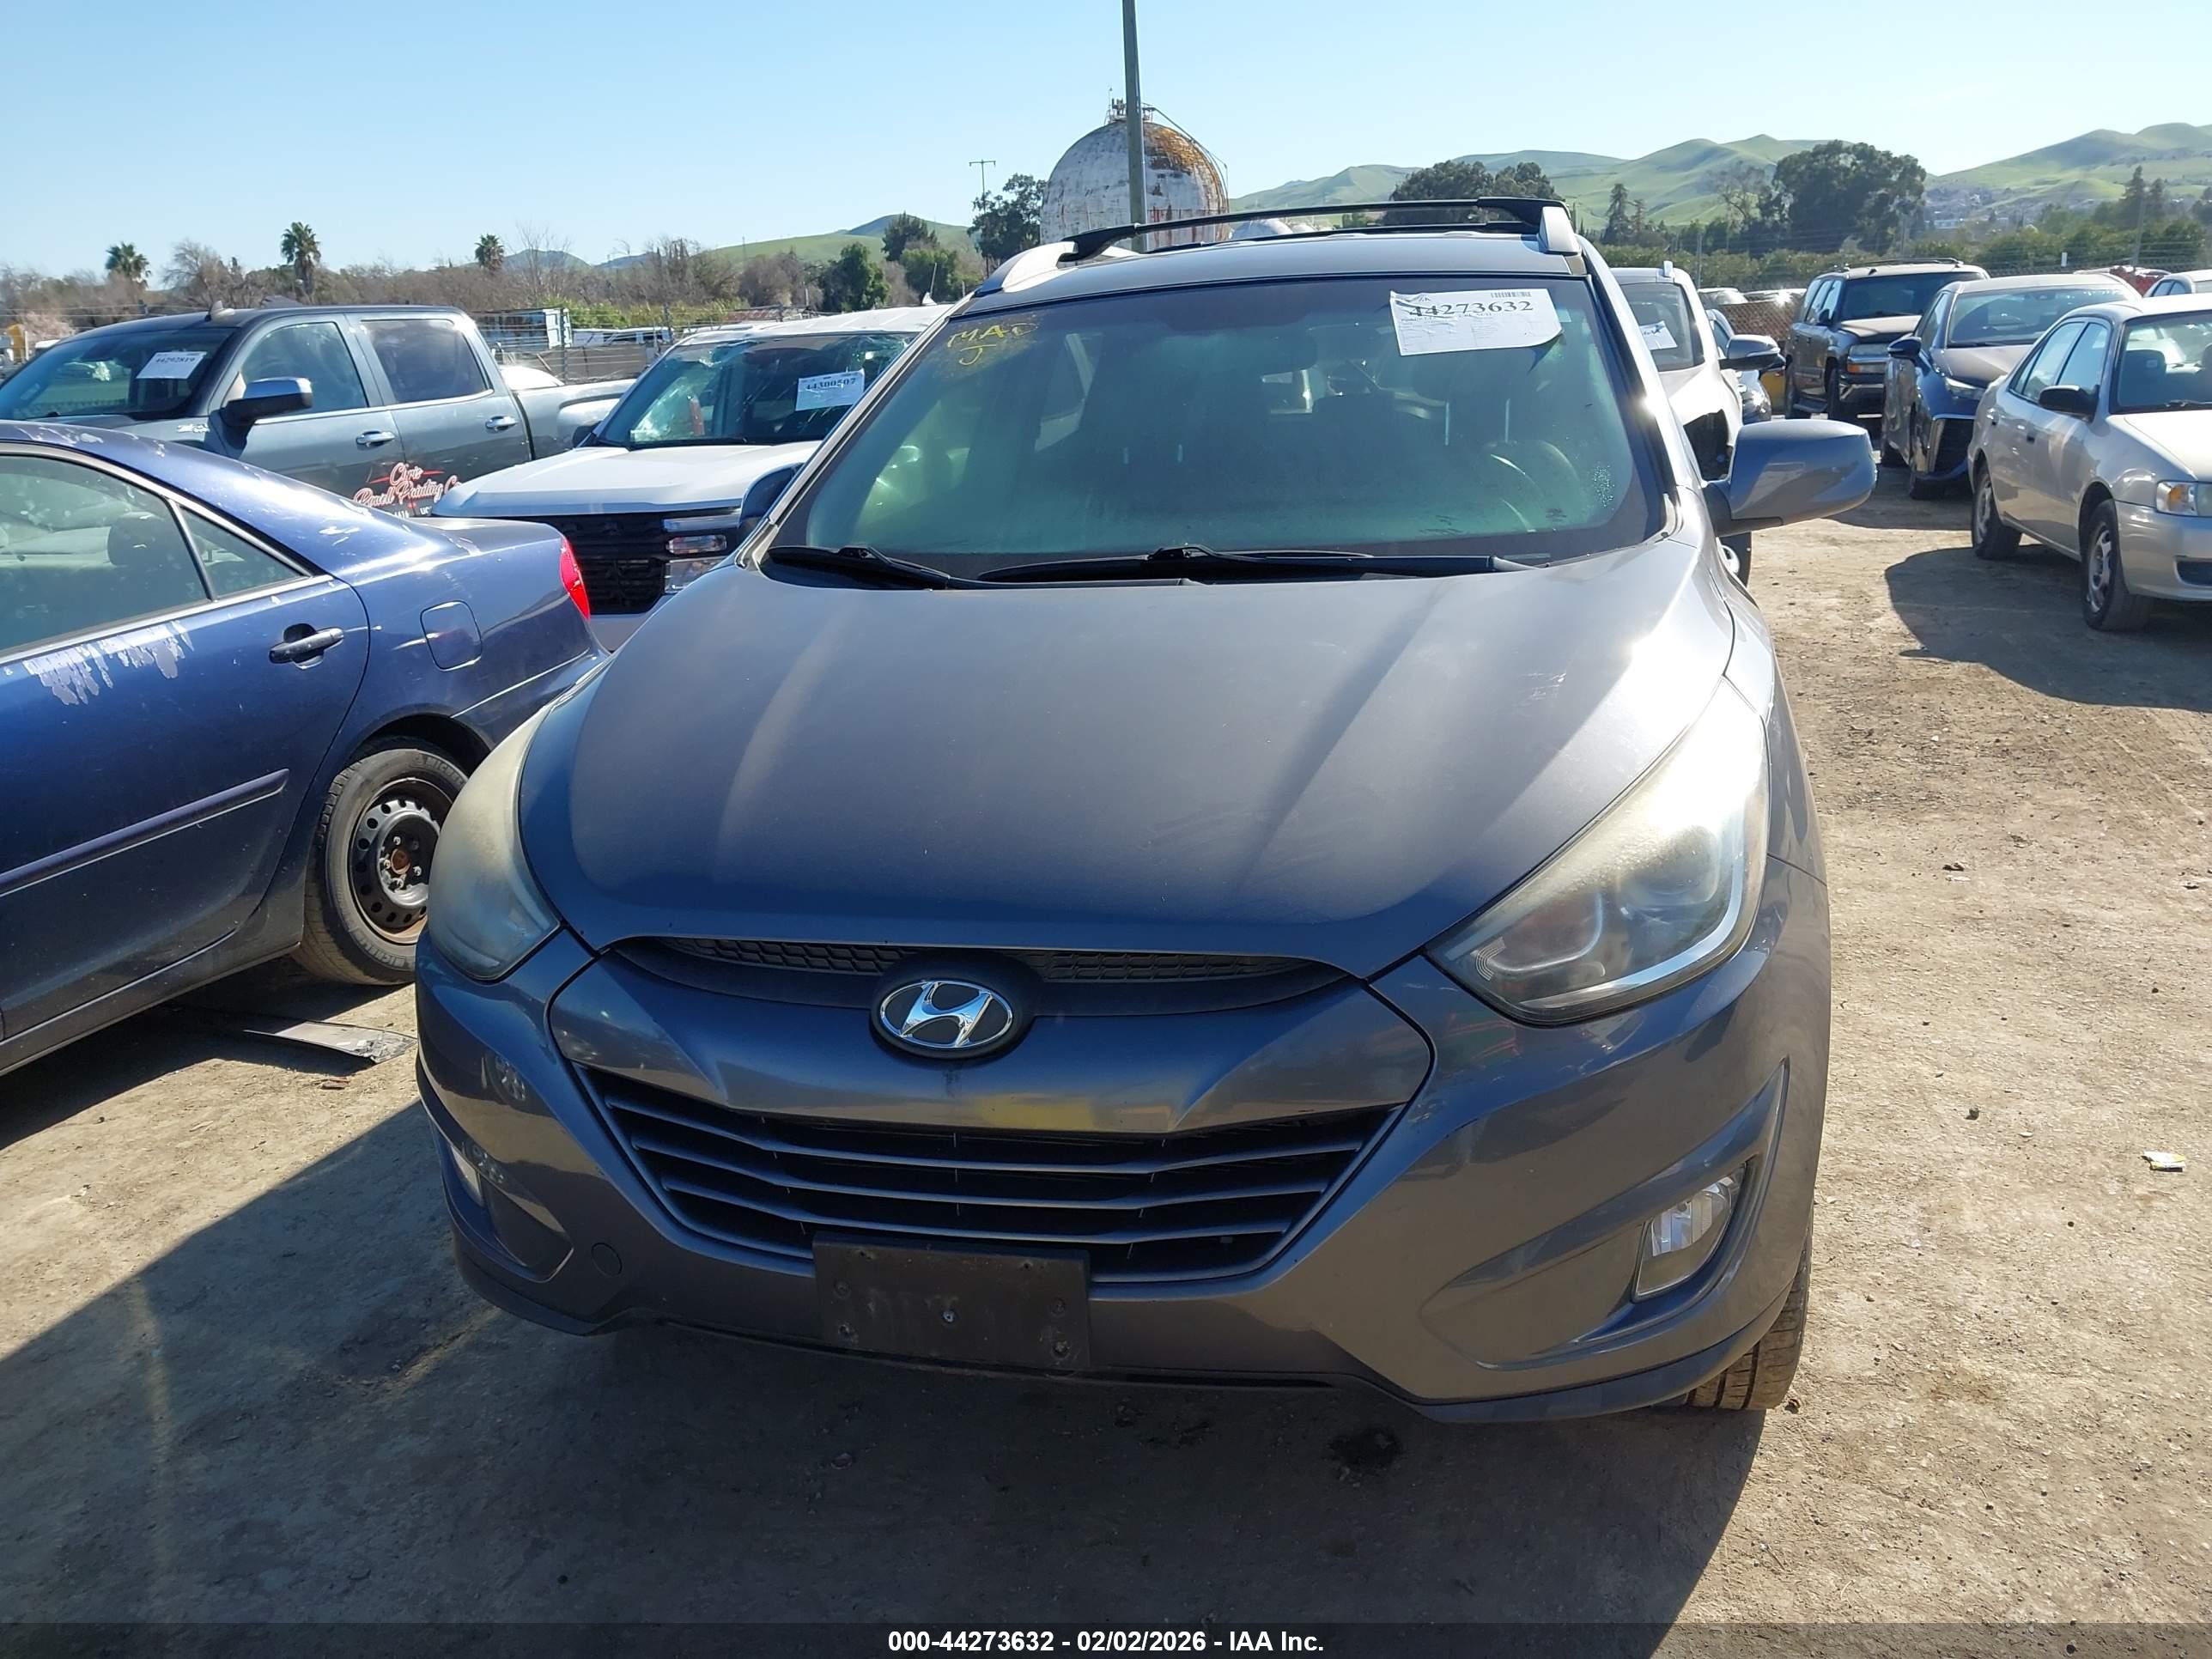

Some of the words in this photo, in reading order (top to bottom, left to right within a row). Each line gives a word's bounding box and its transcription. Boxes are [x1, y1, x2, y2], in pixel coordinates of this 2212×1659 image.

[1409, 301, 1534, 316] 44273632
[389, 462, 424, 486] Chris
[395, 478, 444, 505] Painting
